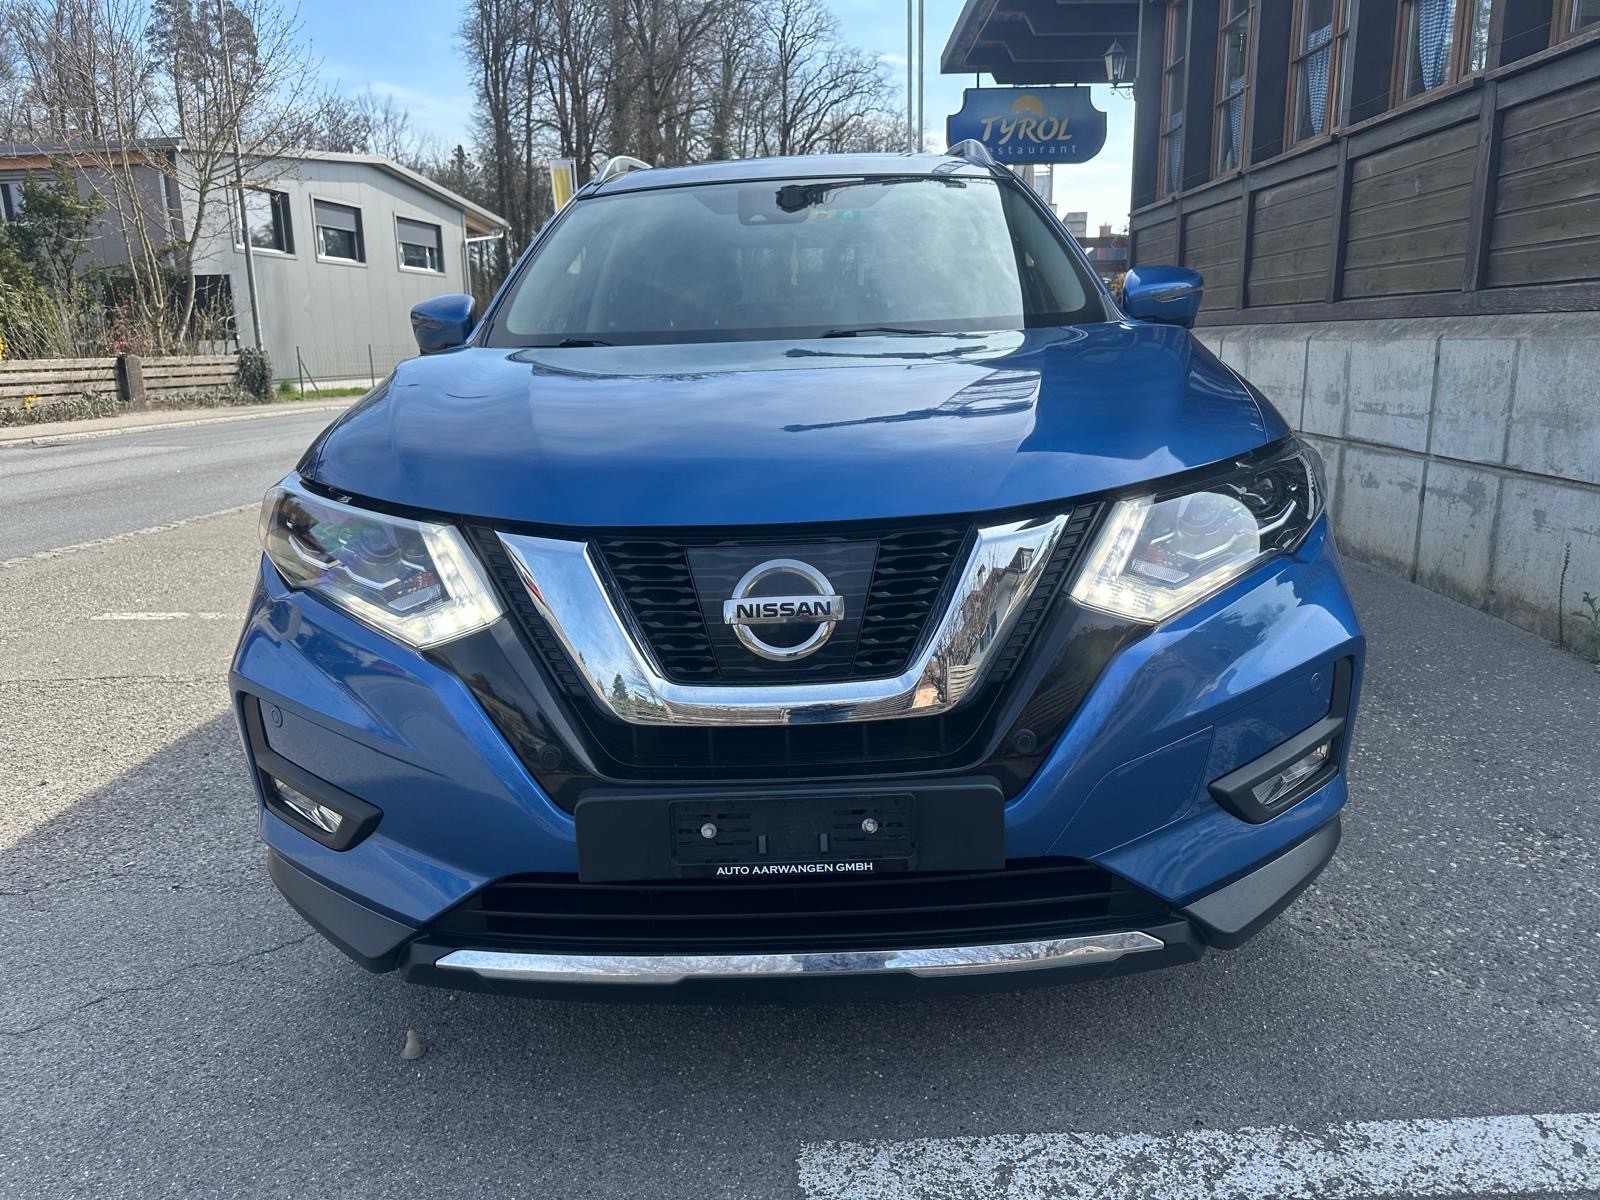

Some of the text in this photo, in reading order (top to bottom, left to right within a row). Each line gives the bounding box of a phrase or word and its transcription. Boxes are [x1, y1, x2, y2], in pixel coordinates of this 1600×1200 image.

[980, 116, 1073, 145] TYROL
[986, 144, 1077, 155] estaurant
[736, 601, 831, 619] NISSAN
[716, 862, 873, 876] AUTO AARWANGEN GMBH
